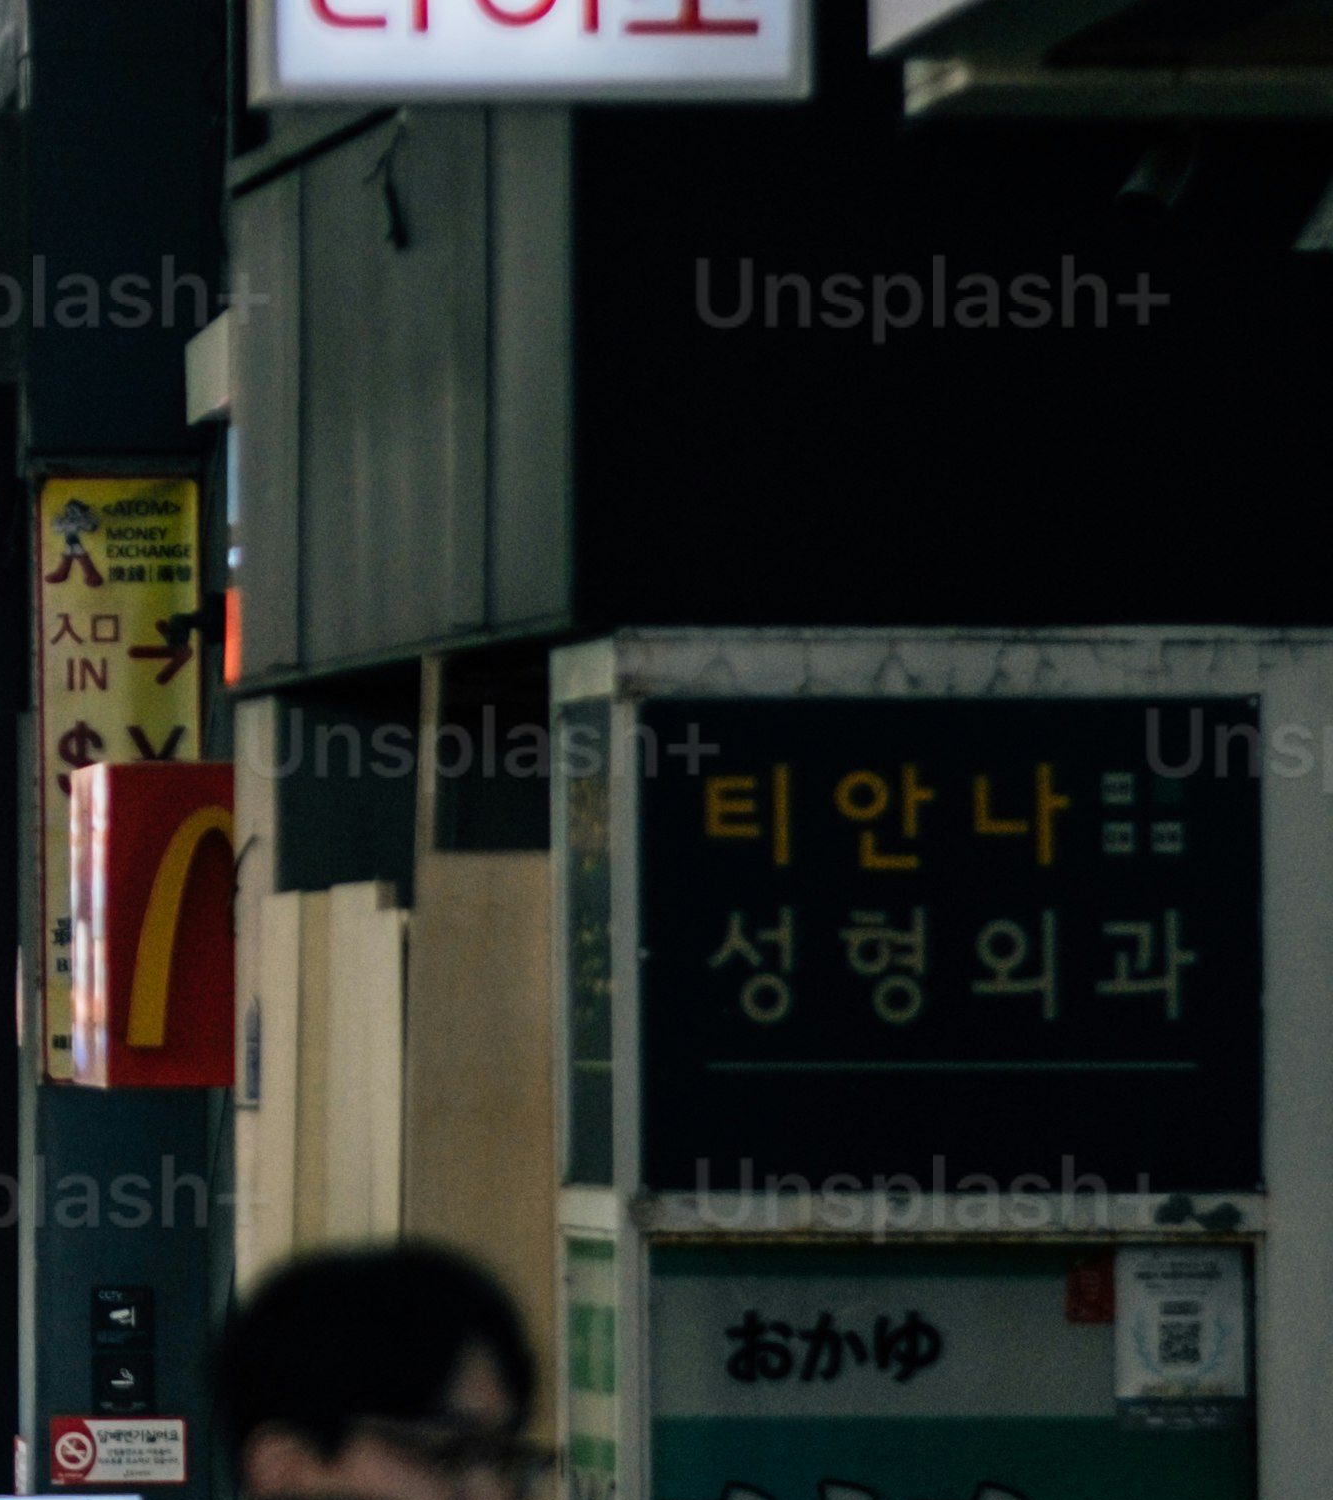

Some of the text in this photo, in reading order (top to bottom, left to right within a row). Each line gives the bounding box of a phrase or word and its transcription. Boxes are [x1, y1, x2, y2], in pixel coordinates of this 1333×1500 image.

[105, 527, 169, 542] MONEY
[105, 543, 191, 559] EXCHANGE
[51, 612, 120, 646] 入口
[66, 657, 109, 692] IN
[703, 760, 1071, 871] 티안나
[708, 908, 1198, 1024] 성형외과
[724, 1310, 943, 1384] おかゆ
